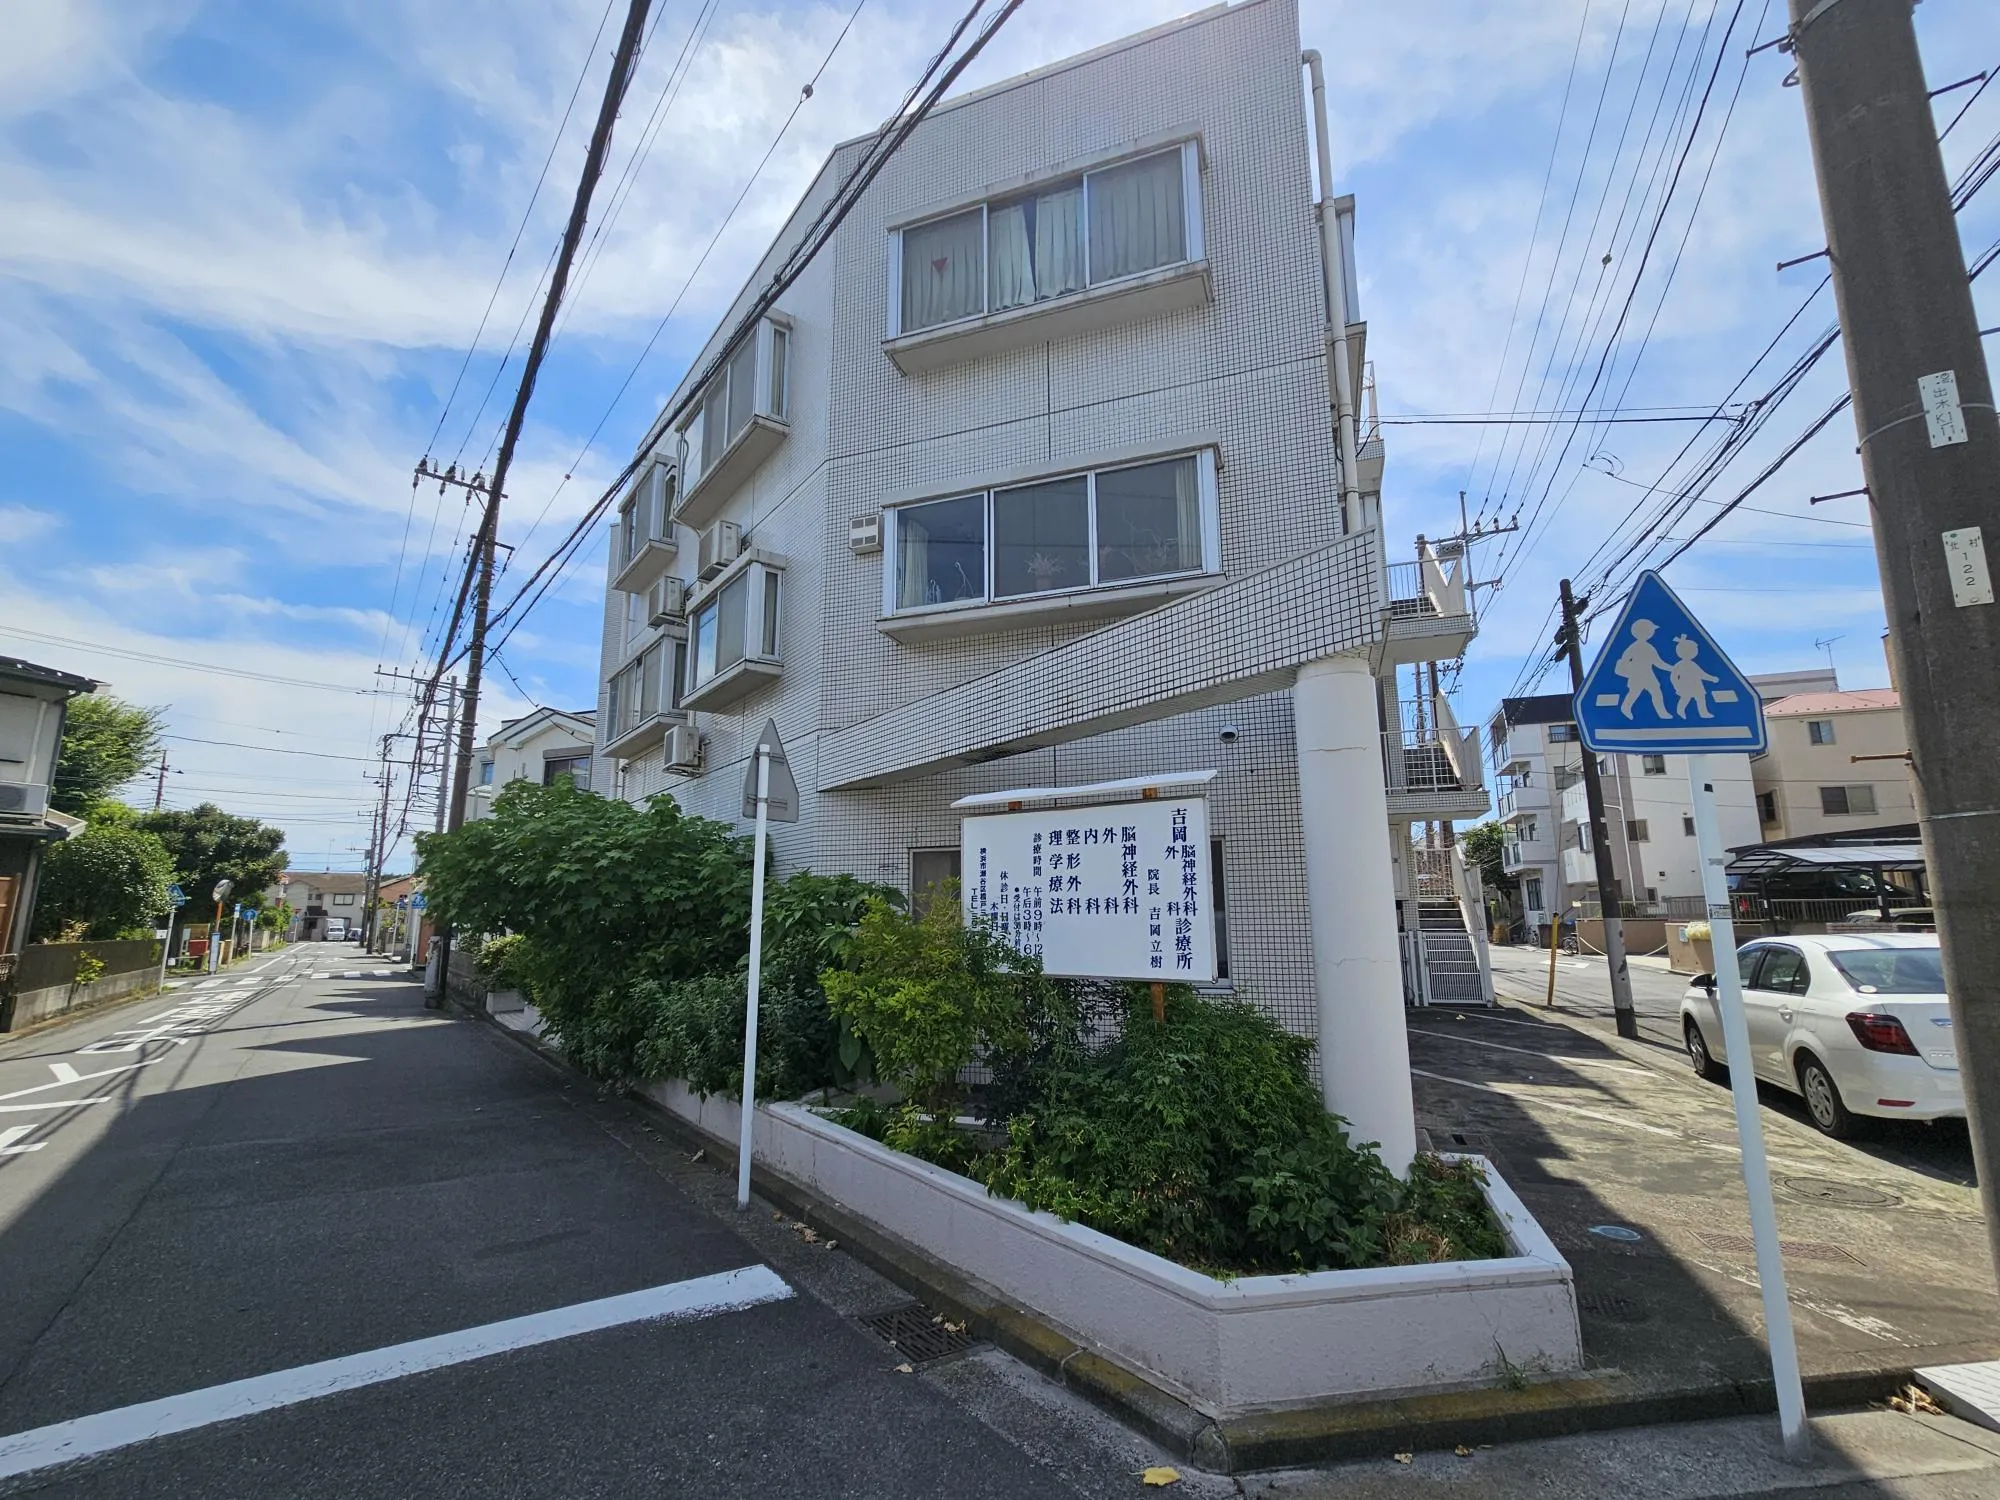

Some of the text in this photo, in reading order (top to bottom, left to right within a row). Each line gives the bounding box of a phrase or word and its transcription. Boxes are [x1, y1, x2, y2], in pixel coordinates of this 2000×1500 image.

[1962, 552, 1976, 586] 122
[1032, 832, 1042, 877] 診療時間
[1048, 830, 1064, 915] 理学療法
[1066, 829, 1082, 915] 整形外科
[1084, 828, 1101, 915] 内科
[1103, 827, 1119, 915] 外科
[1121, 826, 1139, 915] 脳神経外科
[1147, 868, 1162, 969] 院長 吉岡立樹
